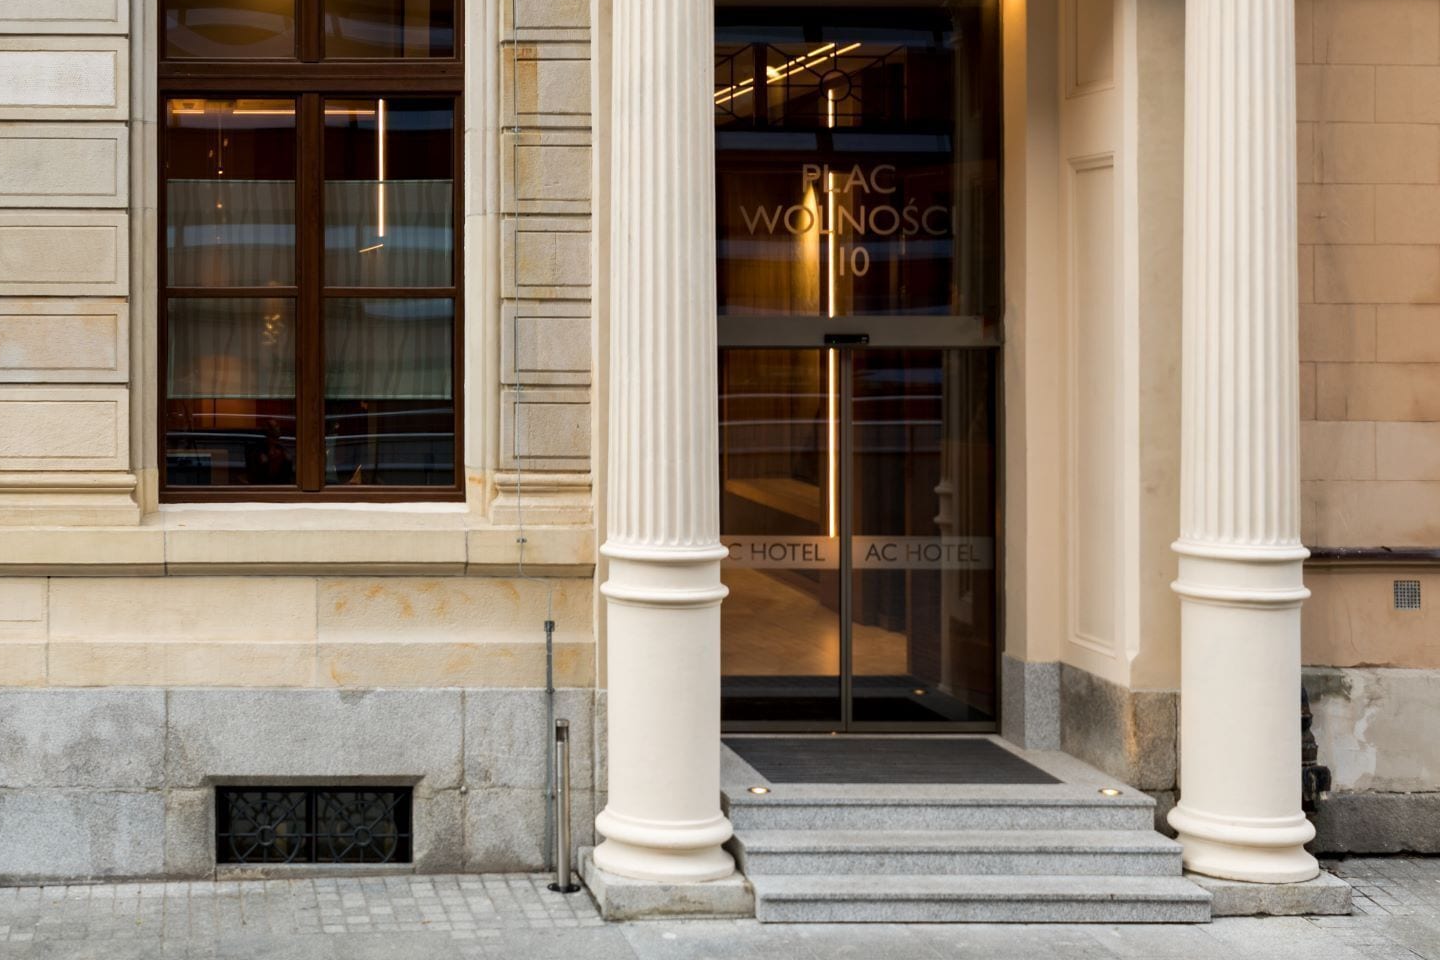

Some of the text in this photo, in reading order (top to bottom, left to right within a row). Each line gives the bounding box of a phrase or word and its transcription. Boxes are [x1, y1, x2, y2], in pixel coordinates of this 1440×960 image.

[803, 164, 896, 193] PLAC
[740, 197, 958, 236] WOLNOŚCI
[839, 246, 870, 277] 10
[751, 543, 825, 561] HOTEL
[865, 543, 981, 562] AC HOTEL
